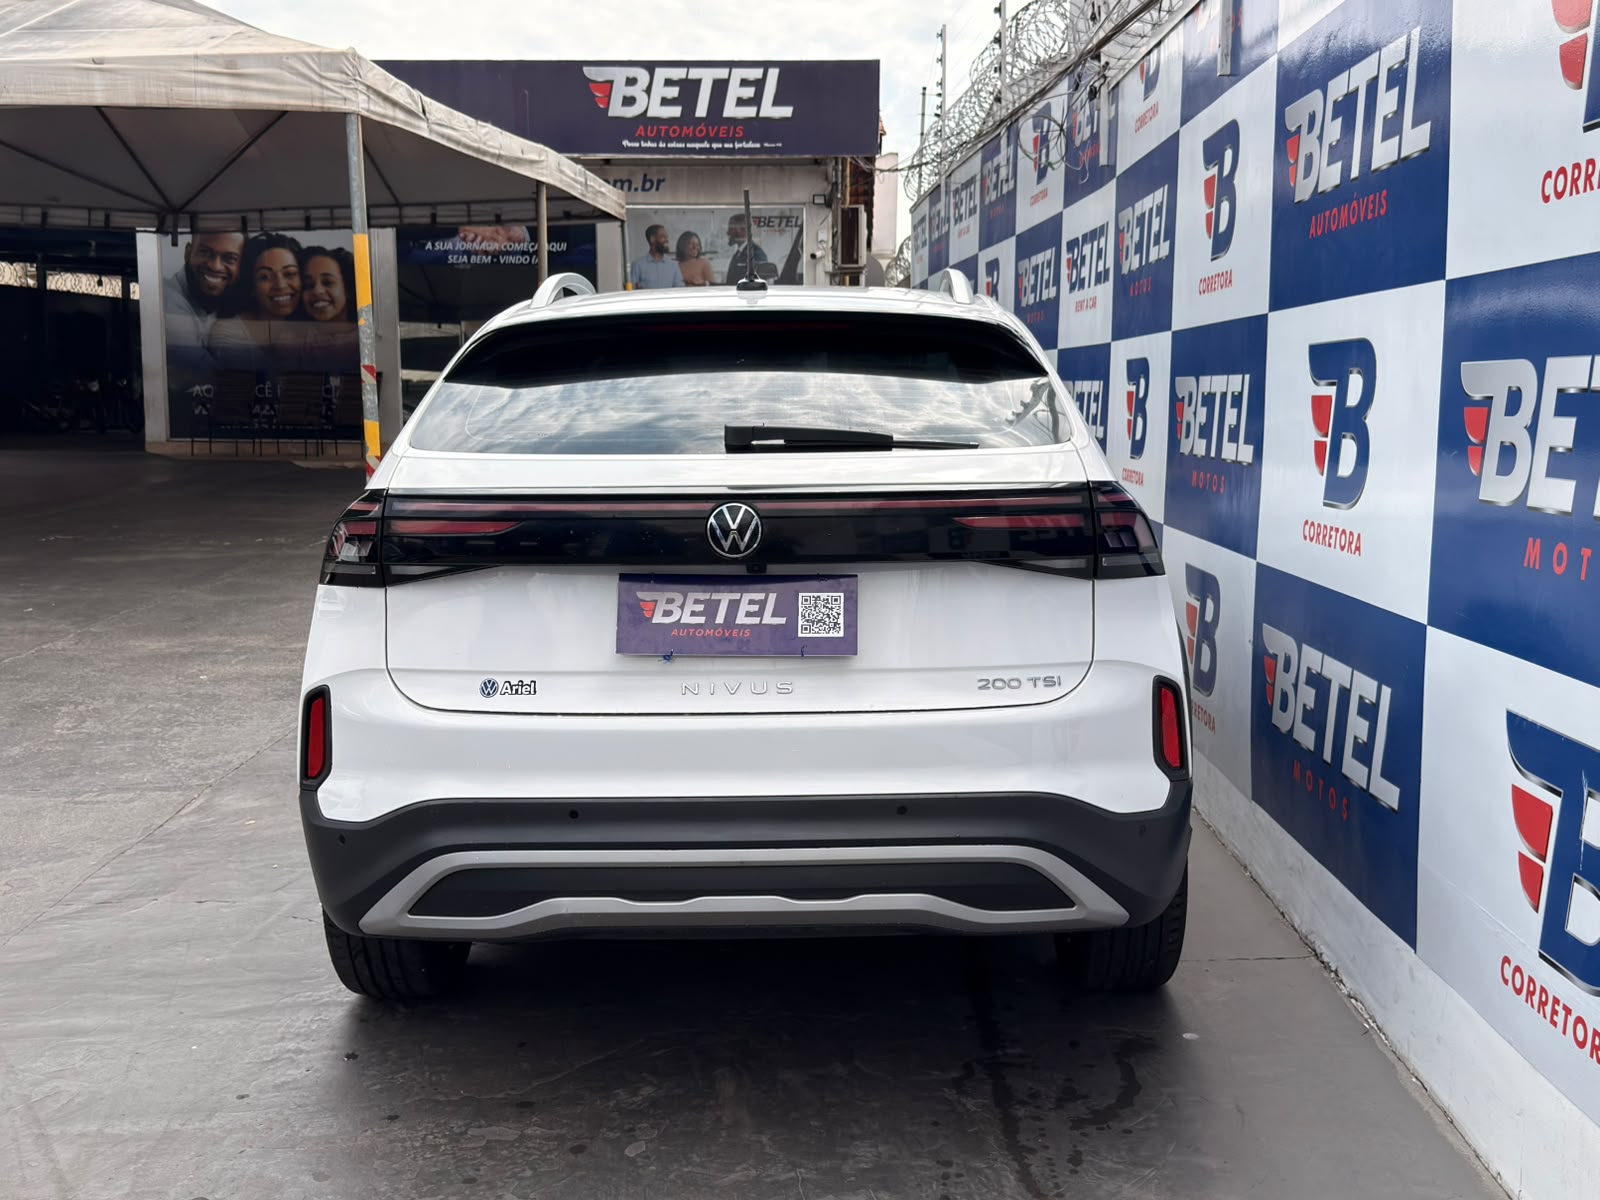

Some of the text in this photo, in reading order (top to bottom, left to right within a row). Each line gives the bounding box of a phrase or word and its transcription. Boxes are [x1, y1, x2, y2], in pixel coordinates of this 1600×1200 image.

[582, 66, 794, 118] BETEL
[635, 123, 744, 138] AUTOMÓVEIS
[1284, 26, 1431, 204] BETEL
[752, 215, 802, 228] BETEL
[1119, 184, 1170, 275] BETEL
[1309, 189, 1388, 239] AUTOMÓVEIS
[425, 241, 433, 250] A
[434, 241, 453, 250] SUA
[455, 241, 499, 251] JORNADA
[447, 255, 468, 264] SEJA
[470, 255, 491, 264] BEM
[499, 255, 529, 264] VINDO
[1066, 221, 1110, 294] BETEL
[1018, 246, 1057, 307] BETEL
[1198, 269, 1233, 297] CORRETORA
[1175, 374, 1254, 466] BETEL
[1461, 355, 1600, 521] BE
[1191, 471, 1225, 494] MOTOS
[1302, 519, 1362, 557] CORRETORA
[636, 591, 787, 624] BETEL
[671, 626, 751, 638] AUTOMÓVEIS
[500, 679, 537, 696] Ariel
[682, 681, 793, 696] NIVUS
[977, 675, 1062, 690] 200 TSI
[1263, 623, 1400, 815] BETEL
[1293, 760, 1348, 820] MOTOS
